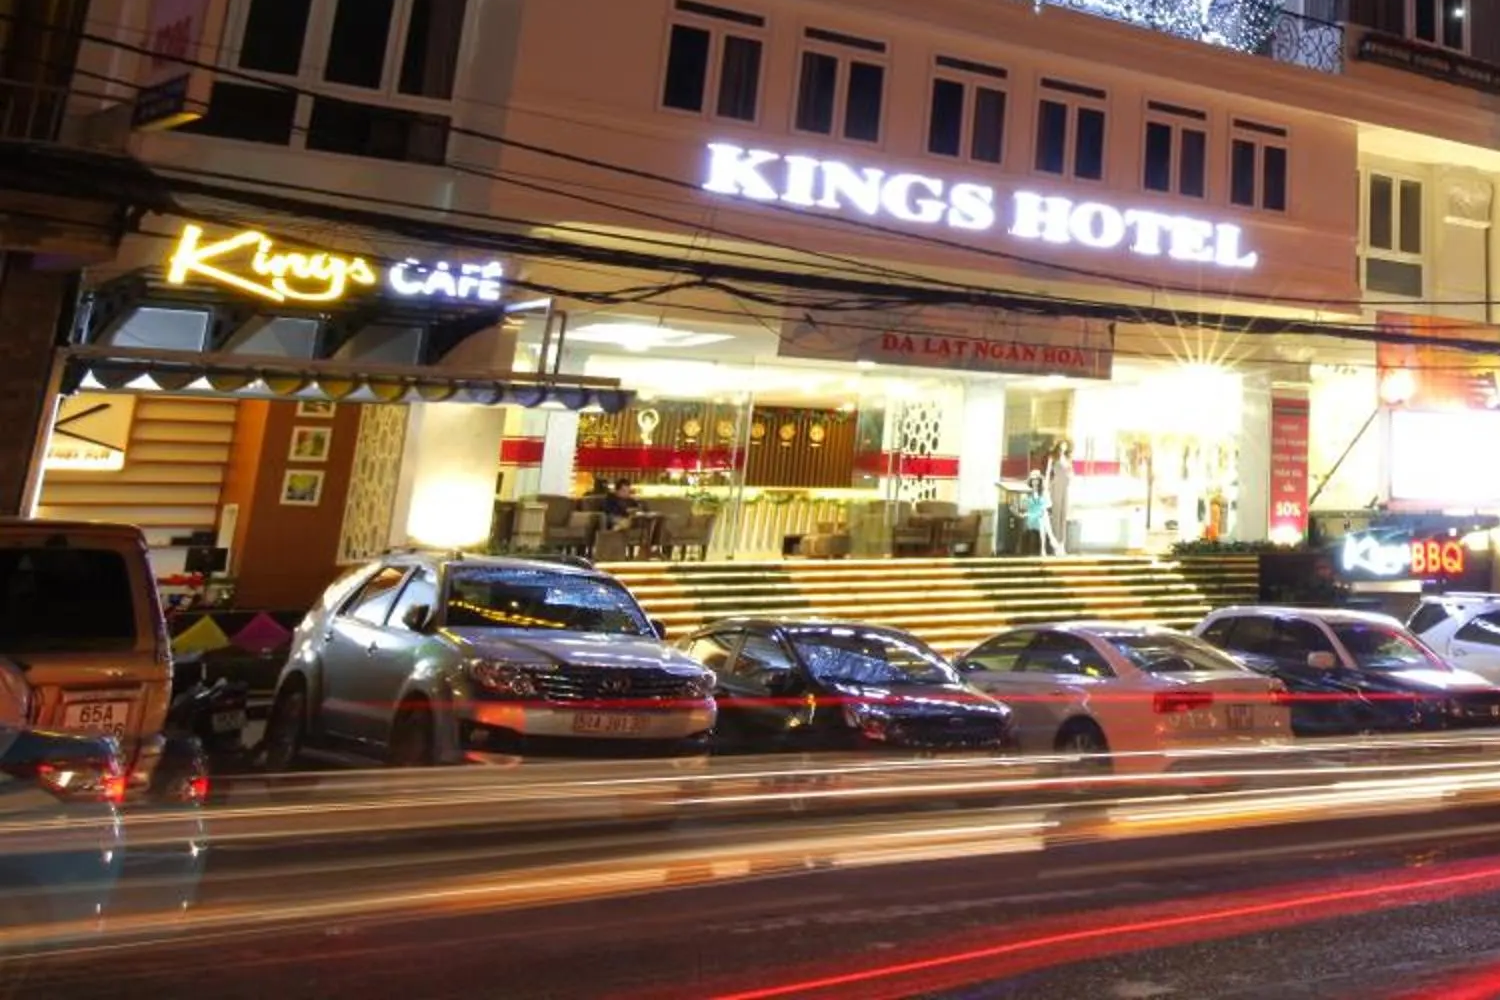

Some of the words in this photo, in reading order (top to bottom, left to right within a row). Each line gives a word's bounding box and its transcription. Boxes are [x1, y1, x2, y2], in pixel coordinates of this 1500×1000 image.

[702, 142, 996, 231] KINGS
[1006, 191, 1258, 269] HOTEL
[166, 223, 377, 302] Kings
[1411, 540, 1464, 573] BBQ
[80, 704, 114, 724] 65A
